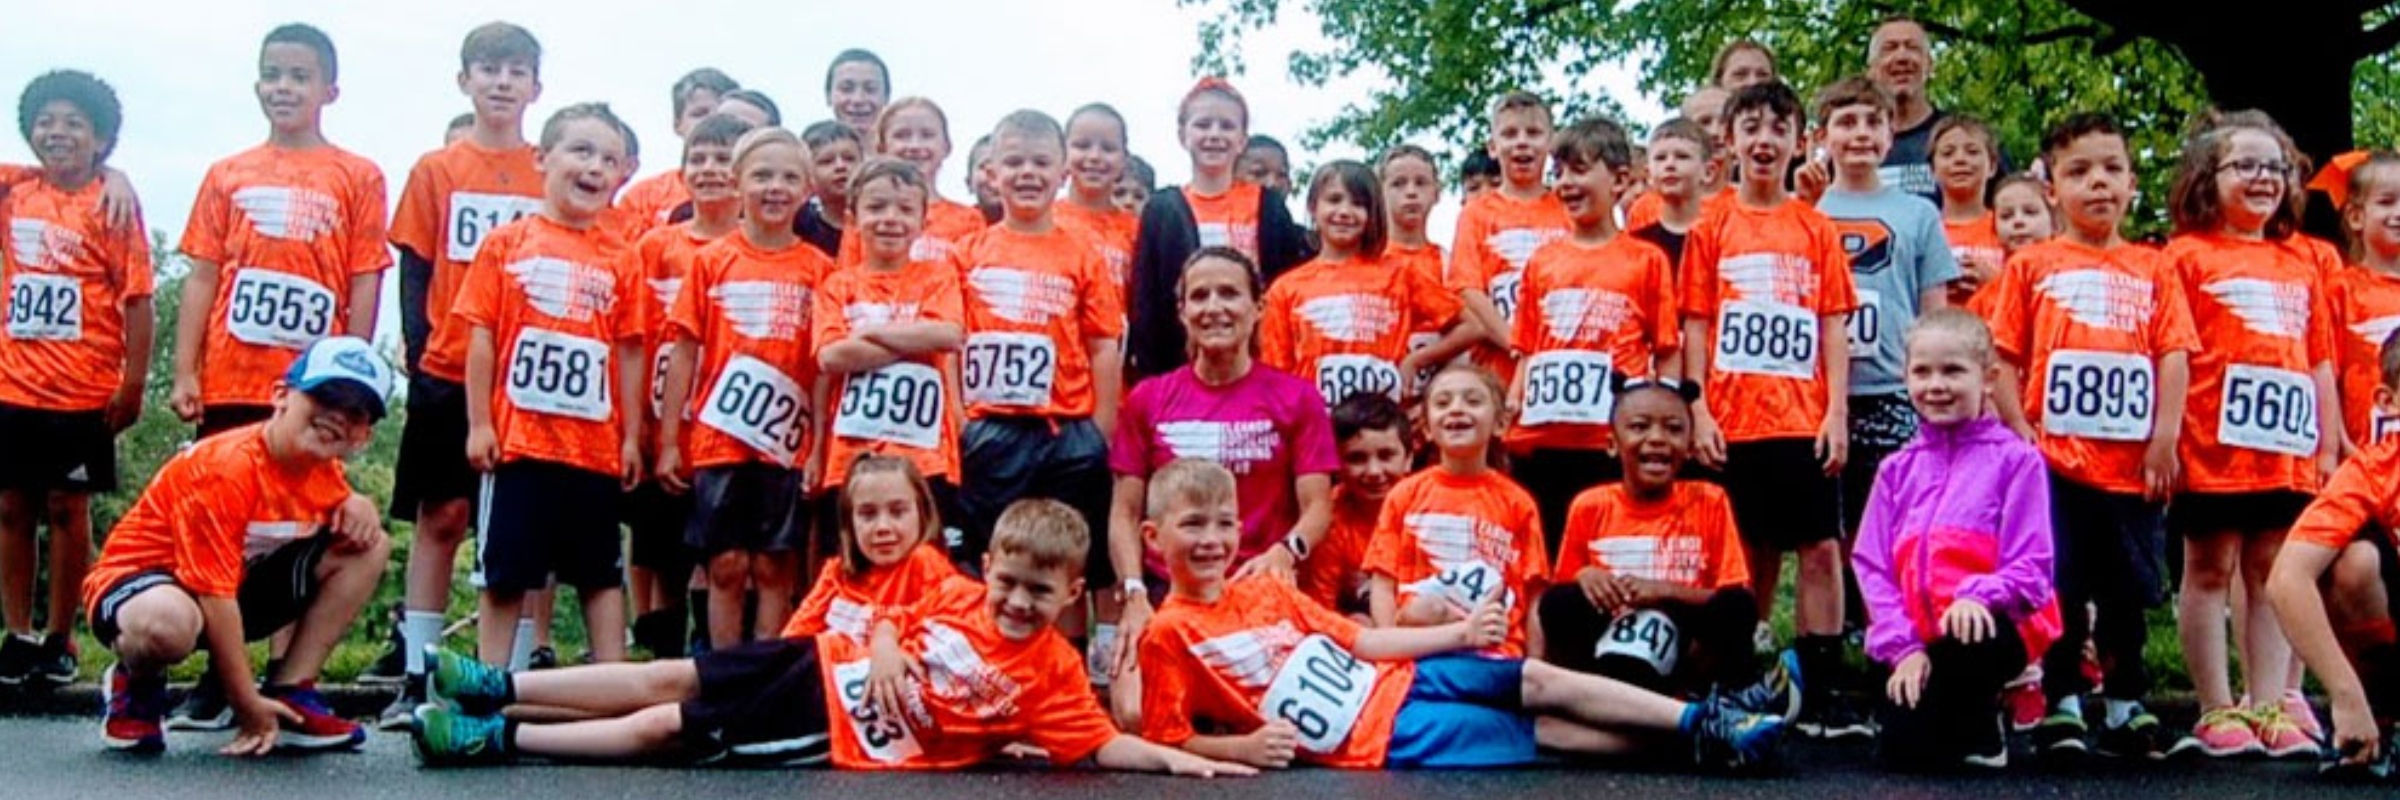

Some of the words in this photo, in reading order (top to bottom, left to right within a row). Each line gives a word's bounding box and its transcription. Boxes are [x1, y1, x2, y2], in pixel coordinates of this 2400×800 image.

[232, 280, 331, 336] 5553
[1721, 312, 1813, 361] 5885
[513, 340, 606, 401] 5581
[966, 344, 1049, 389] 5752
[1527, 361, 1607, 407] 5587
[2048, 364, 2148, 419] 5893
[717, 371, 811, 451] 6025
[841, 372, 939, 428] 5590
[1278, 639, 1363, 742] 6104
